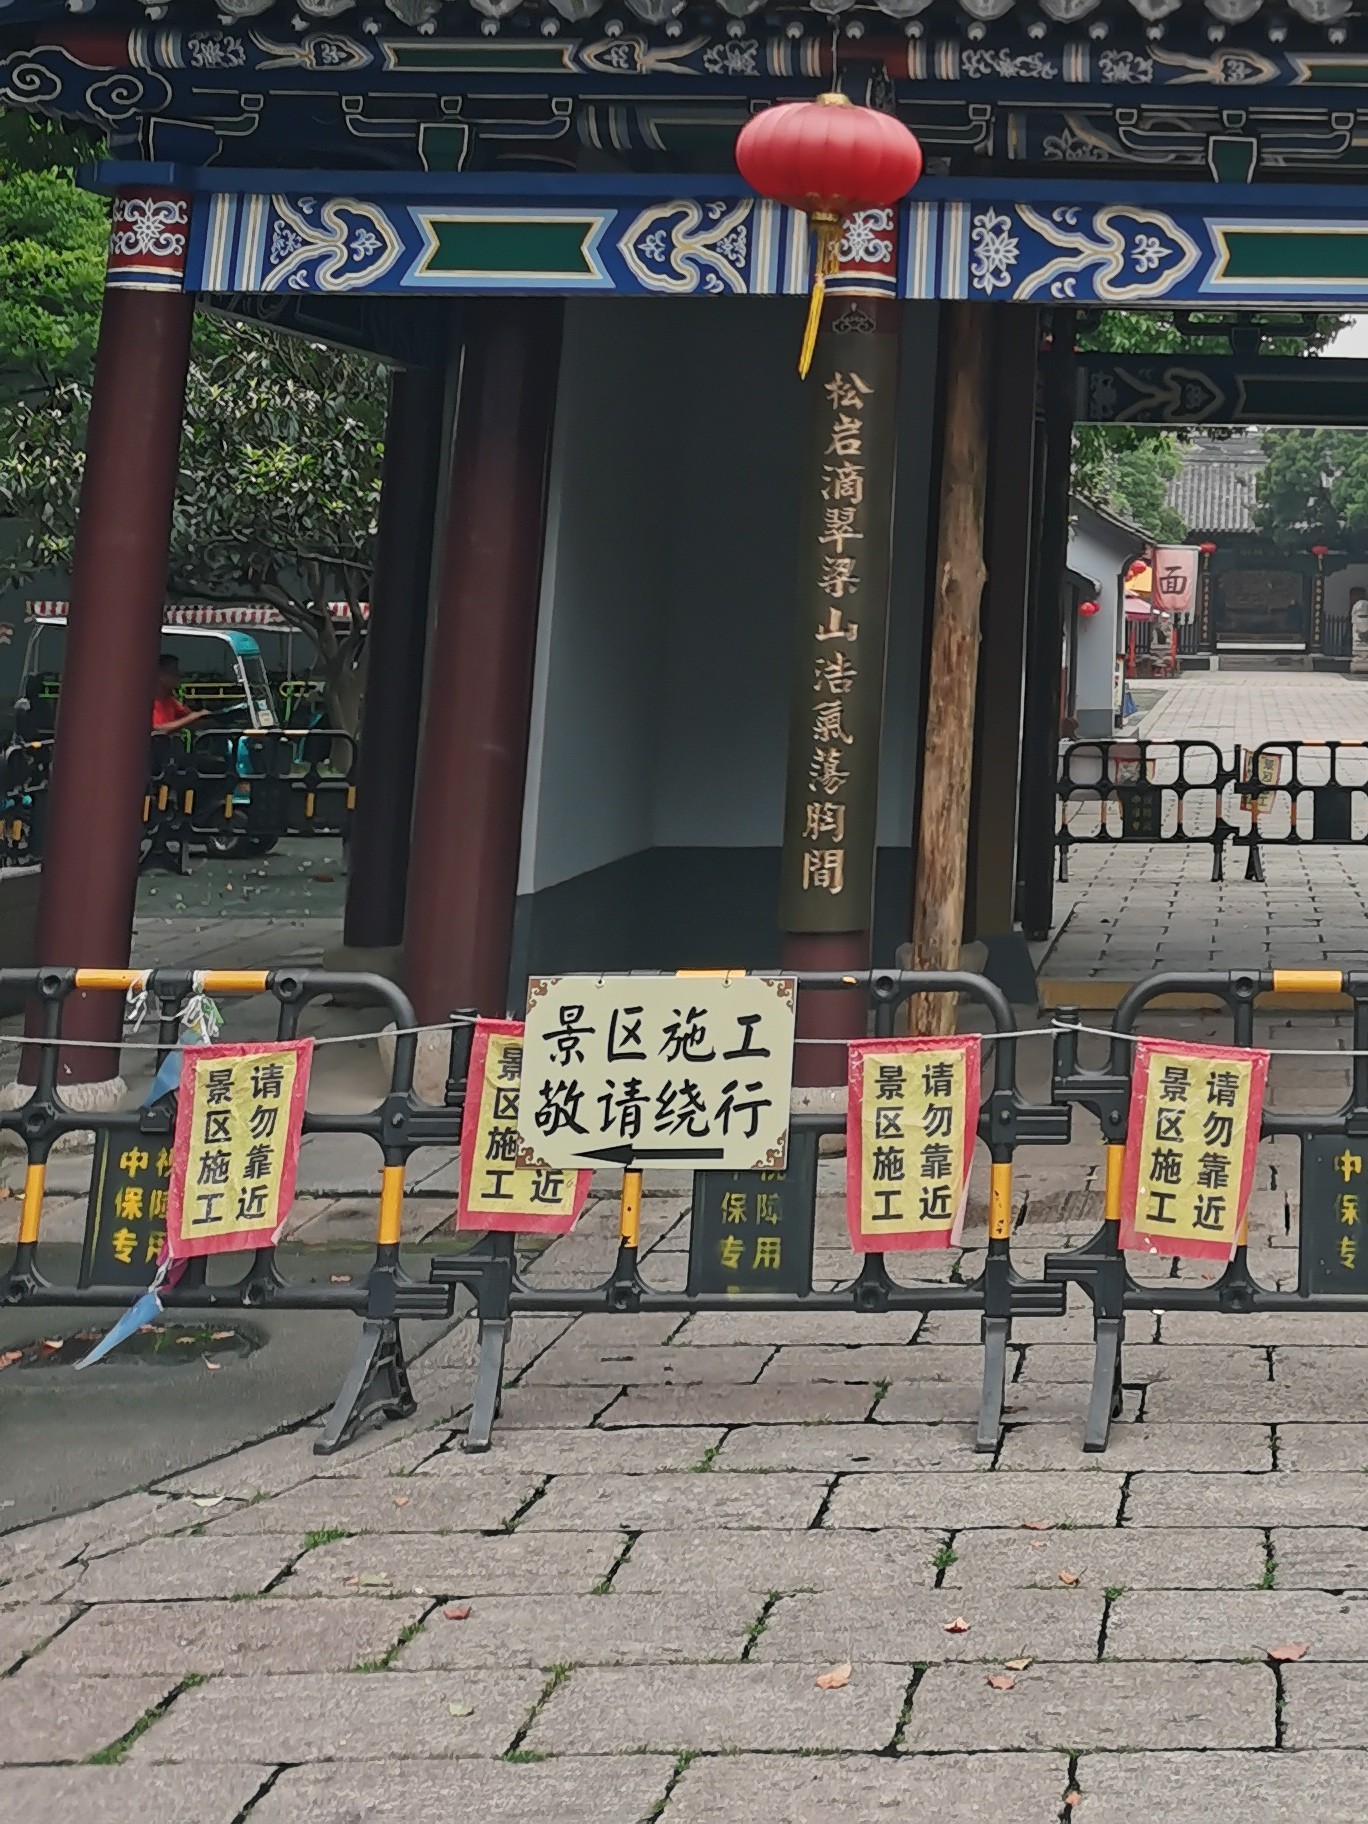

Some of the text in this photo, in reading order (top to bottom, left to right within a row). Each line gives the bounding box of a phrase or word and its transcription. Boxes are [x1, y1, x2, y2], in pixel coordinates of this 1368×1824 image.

[1159, 565, 1187, 594] 面
[535, 1077, 772, 1139] 敬请绕行
[542, 1005, 771, 1066] 景区施工
[192, 1068, 235, 1225] 景区施工
[236, 1063, 284, 1221] 请勿靠近
[720, 1192, 783, 1225] 保障
[872, 1065, 907, 1221] 景区施工
[918, 1062, 953, 1221] 请勿靠近
[1145, 1065, 1192, 1225] 景区施工
[1192, 1071, 1240, 1231] 请勿靠近
[719, 1236, 782, 1270] 专用
